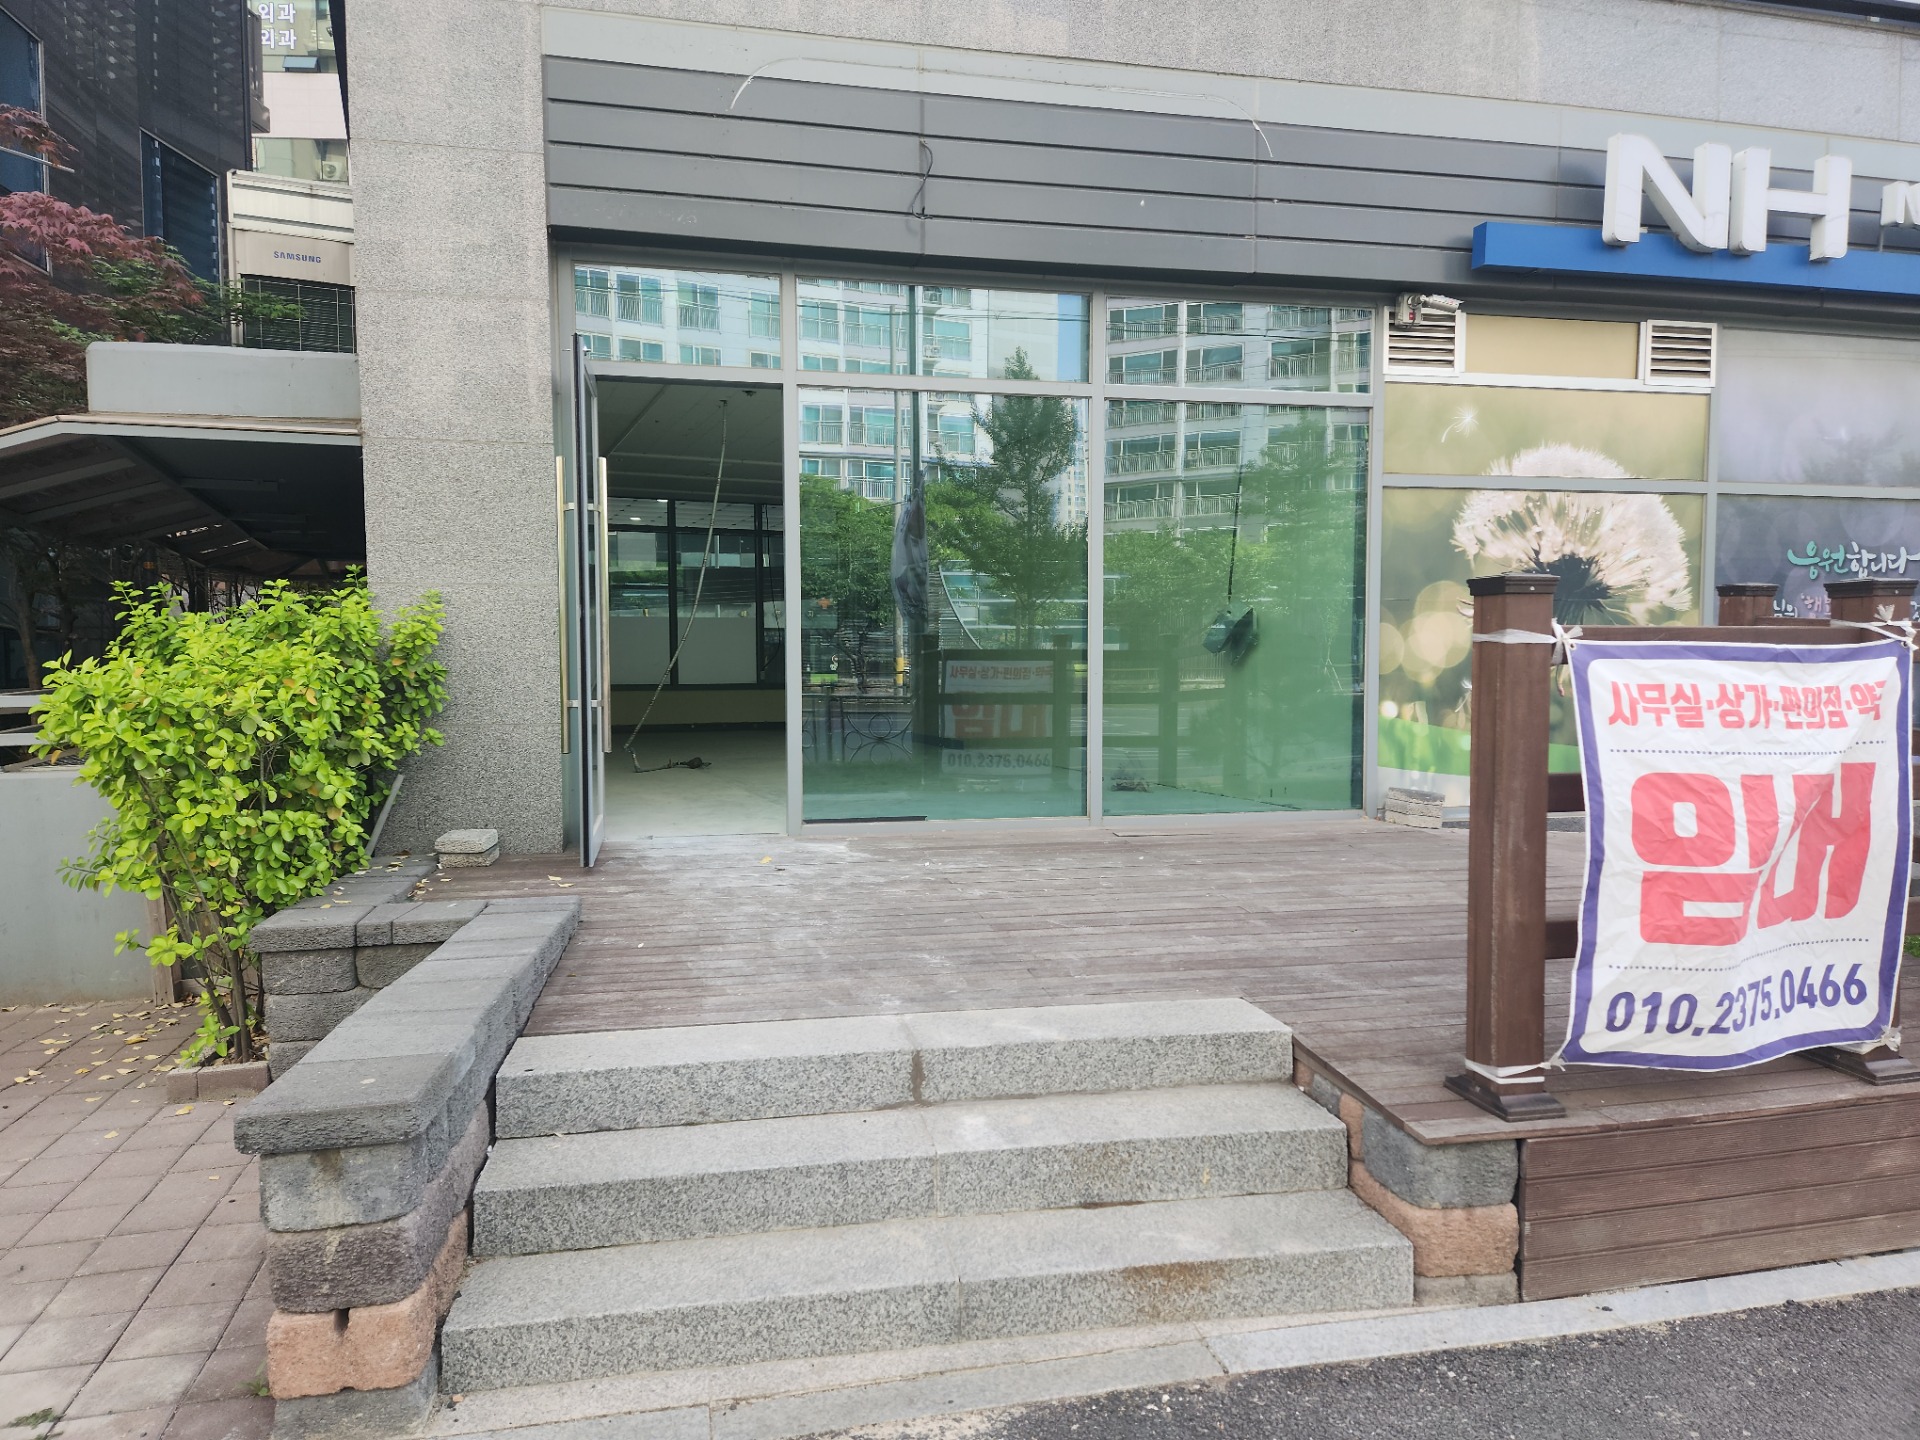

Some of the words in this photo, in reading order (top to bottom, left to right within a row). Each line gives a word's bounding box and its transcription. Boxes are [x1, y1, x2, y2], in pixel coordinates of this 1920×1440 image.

[258, 2, 296, 24] 외과
[261, 28, 297, 50] 외과
[1602, 132, 1852, 262] NH
[273, 250, 322, 264] SAMSUNG
[1787, 540, 1920, 580] 응원합니다
[1608, 680, 1887, 730] 사무실·상가·편의점·약
[1630, 762, 1877, 947] 임대
[1604, 963, 1868, 1038] 010.2375.0466
